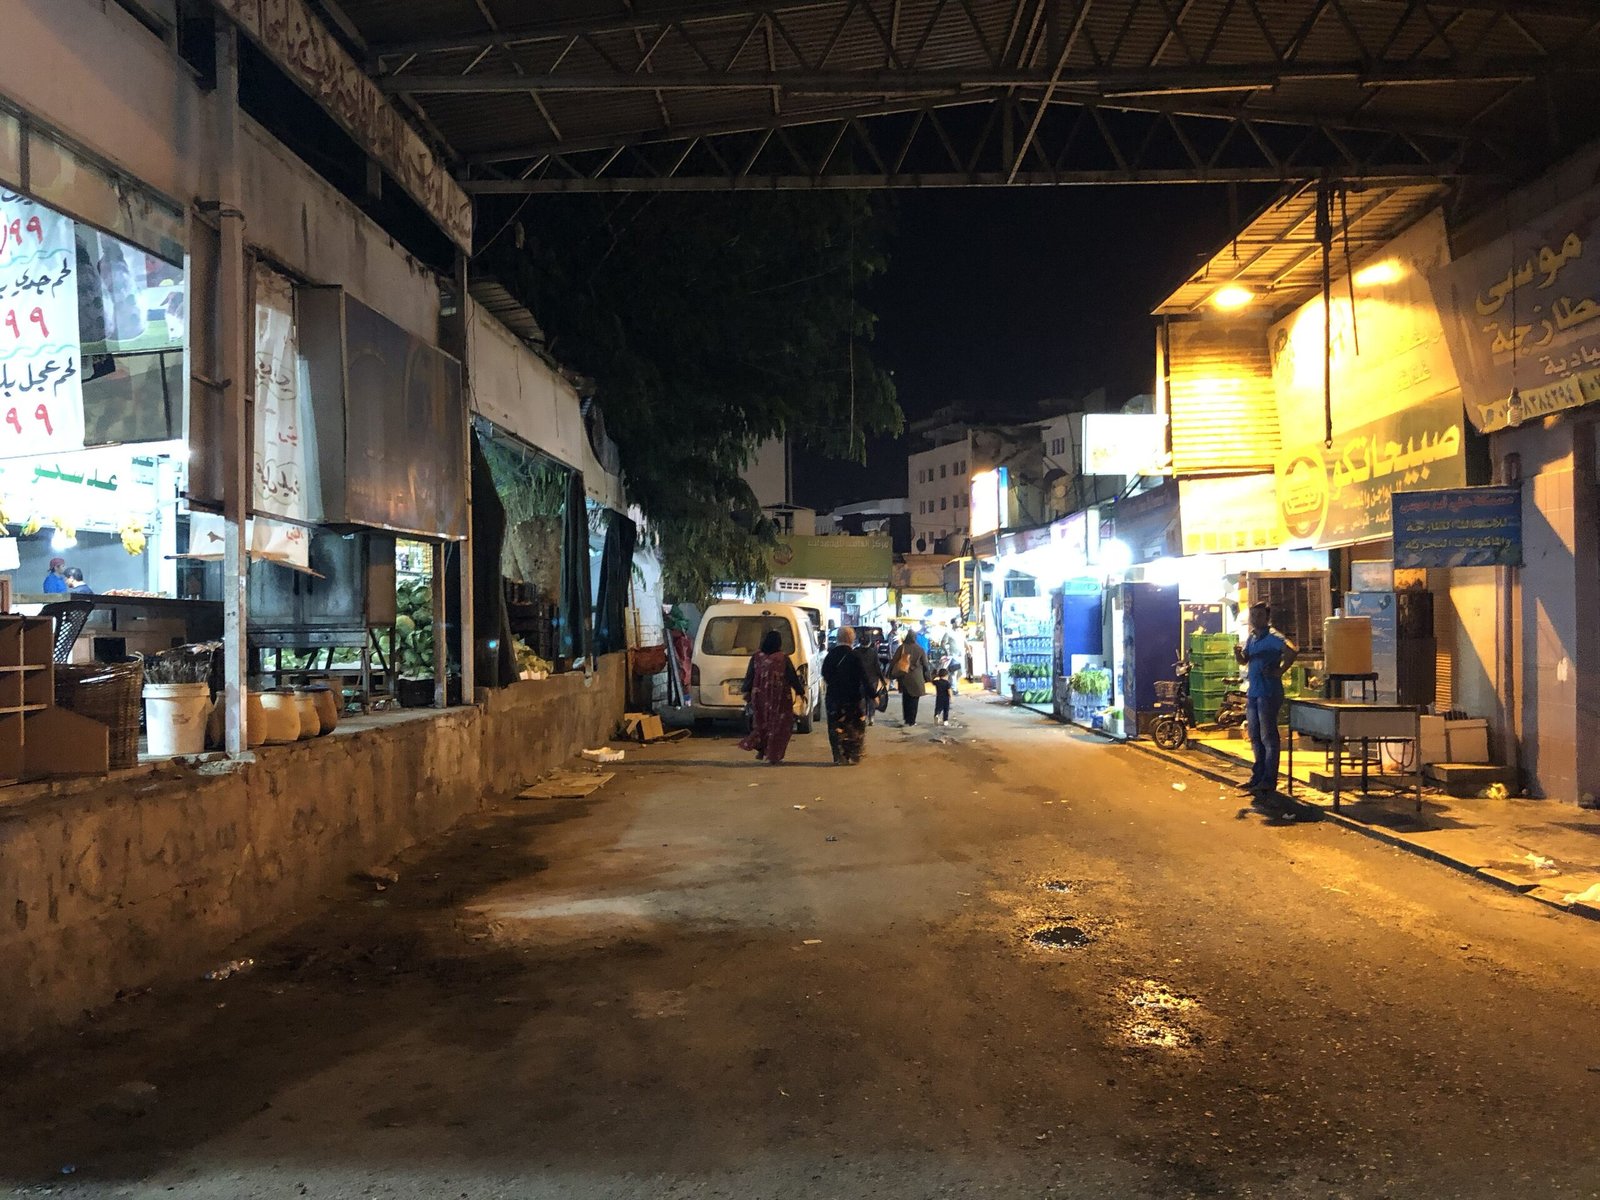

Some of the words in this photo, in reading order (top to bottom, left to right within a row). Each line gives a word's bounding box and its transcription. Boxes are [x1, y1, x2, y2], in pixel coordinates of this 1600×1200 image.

[11, 268, 51, 297] جدي
[51, 258, 71, 298] لحم
[1475, 232, 1582, 316] موسى
[19, 360, 61, 392] عجل
[53, 356, 76, 398] لحم
[1539, 345, 1600, 378] يادية
[1331, 424, 1461, 500] صبيحاتكو
